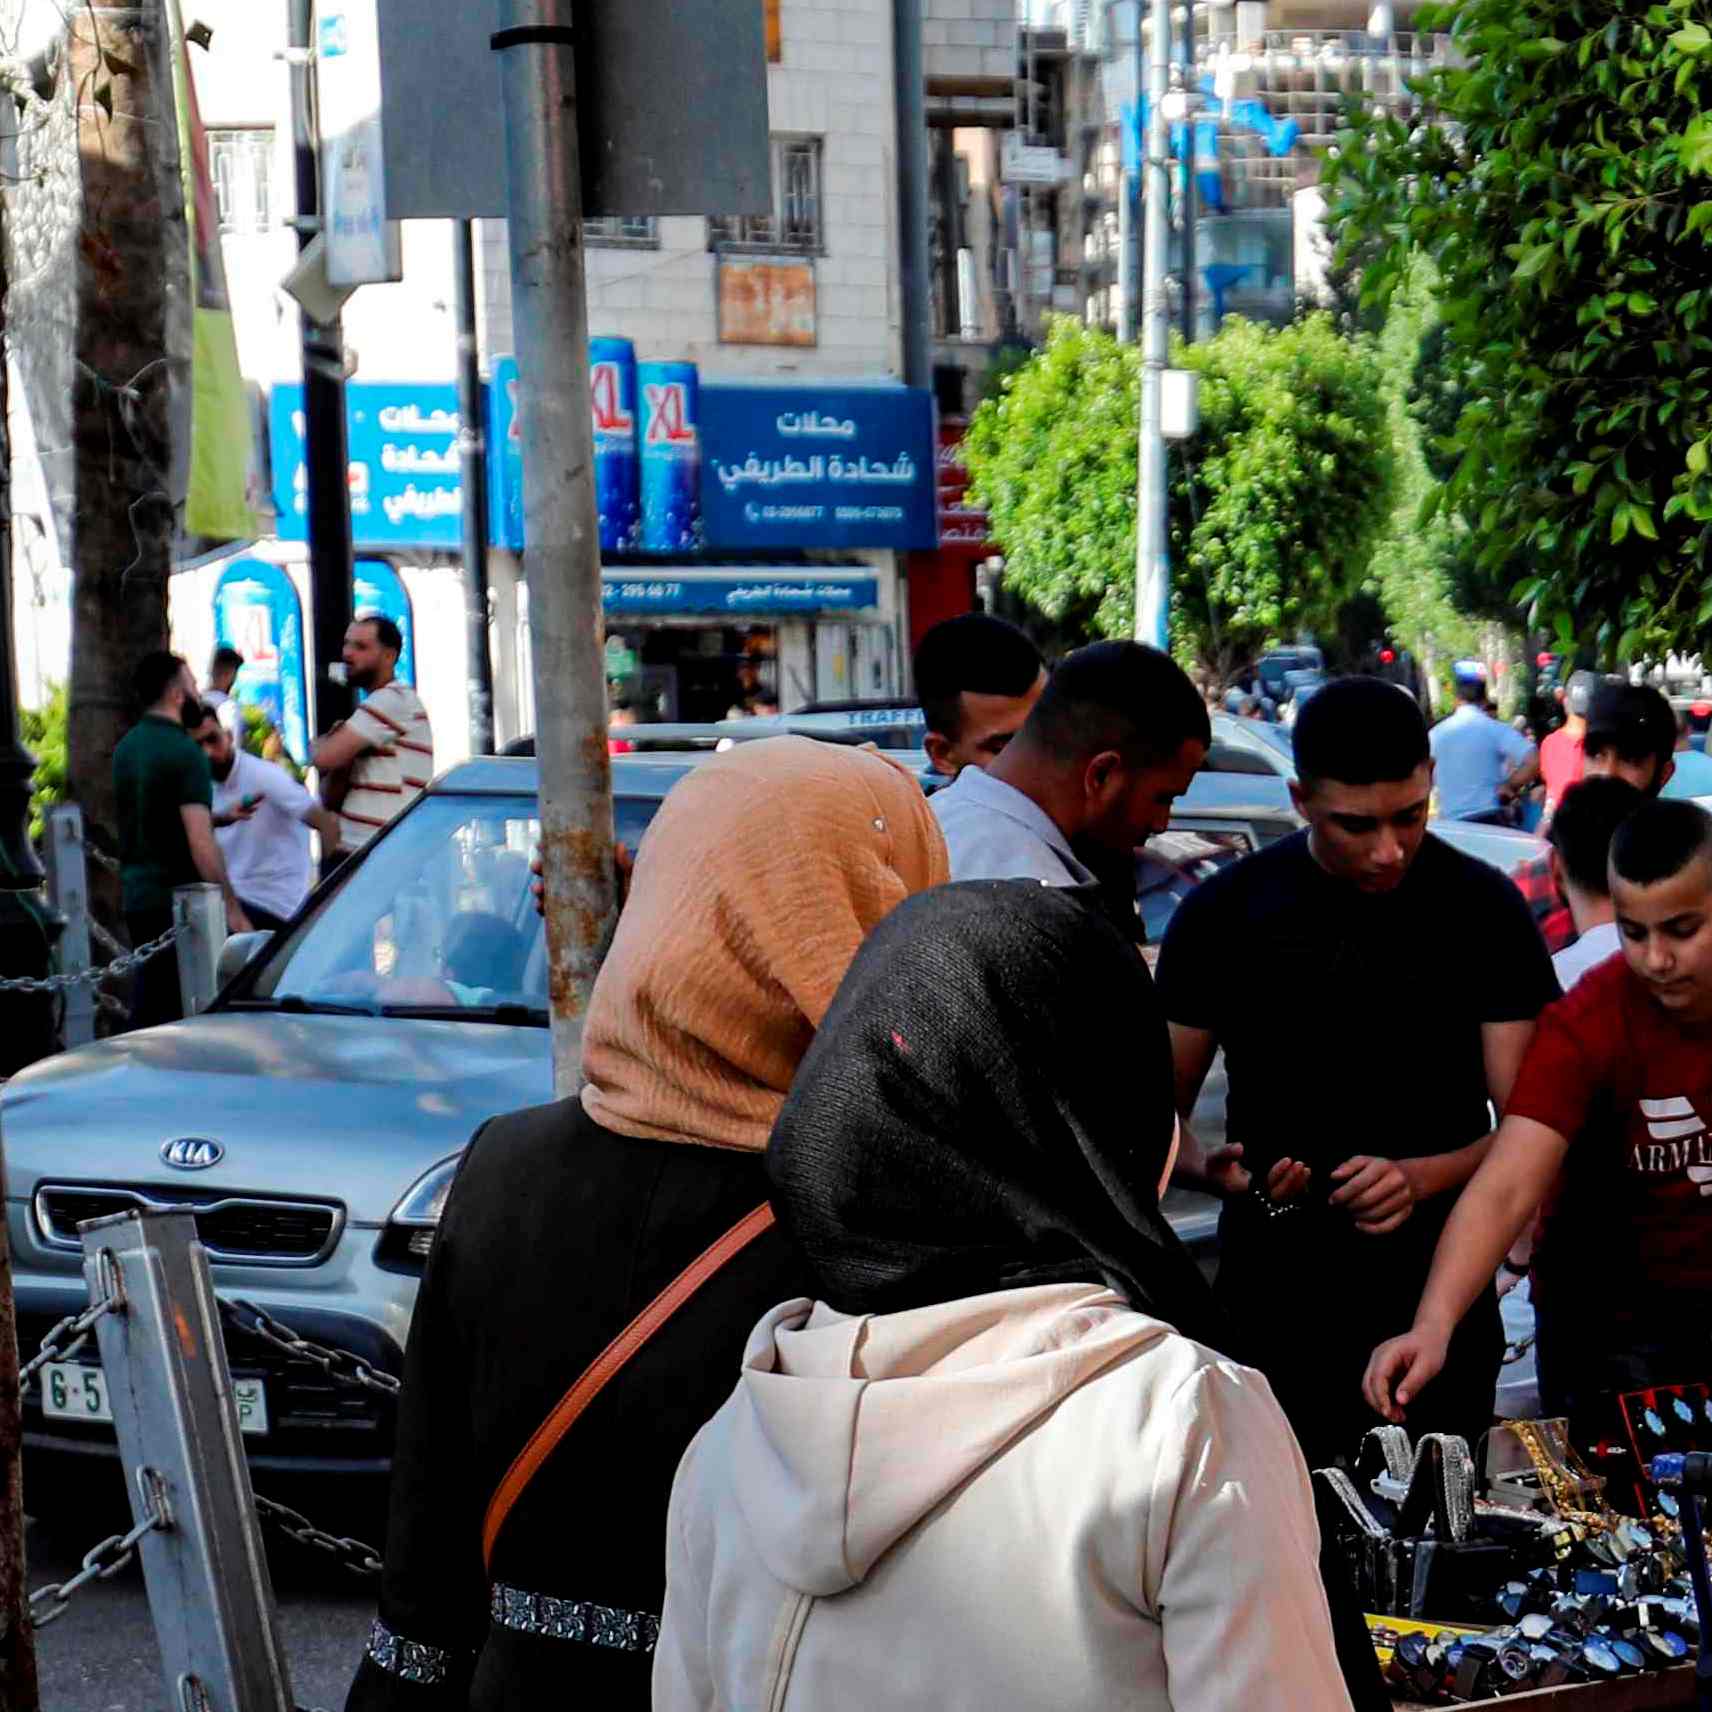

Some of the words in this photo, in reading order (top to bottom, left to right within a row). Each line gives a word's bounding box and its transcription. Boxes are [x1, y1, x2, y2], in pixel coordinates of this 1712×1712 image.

[646, 385, 695, 441] XL
[776, 410, 856, 438] محلات
[717, 452, 824, 489] الطريفي
[828, 452, 916, 482] شحادة
[168, 1140, 210, 1163] KIA
